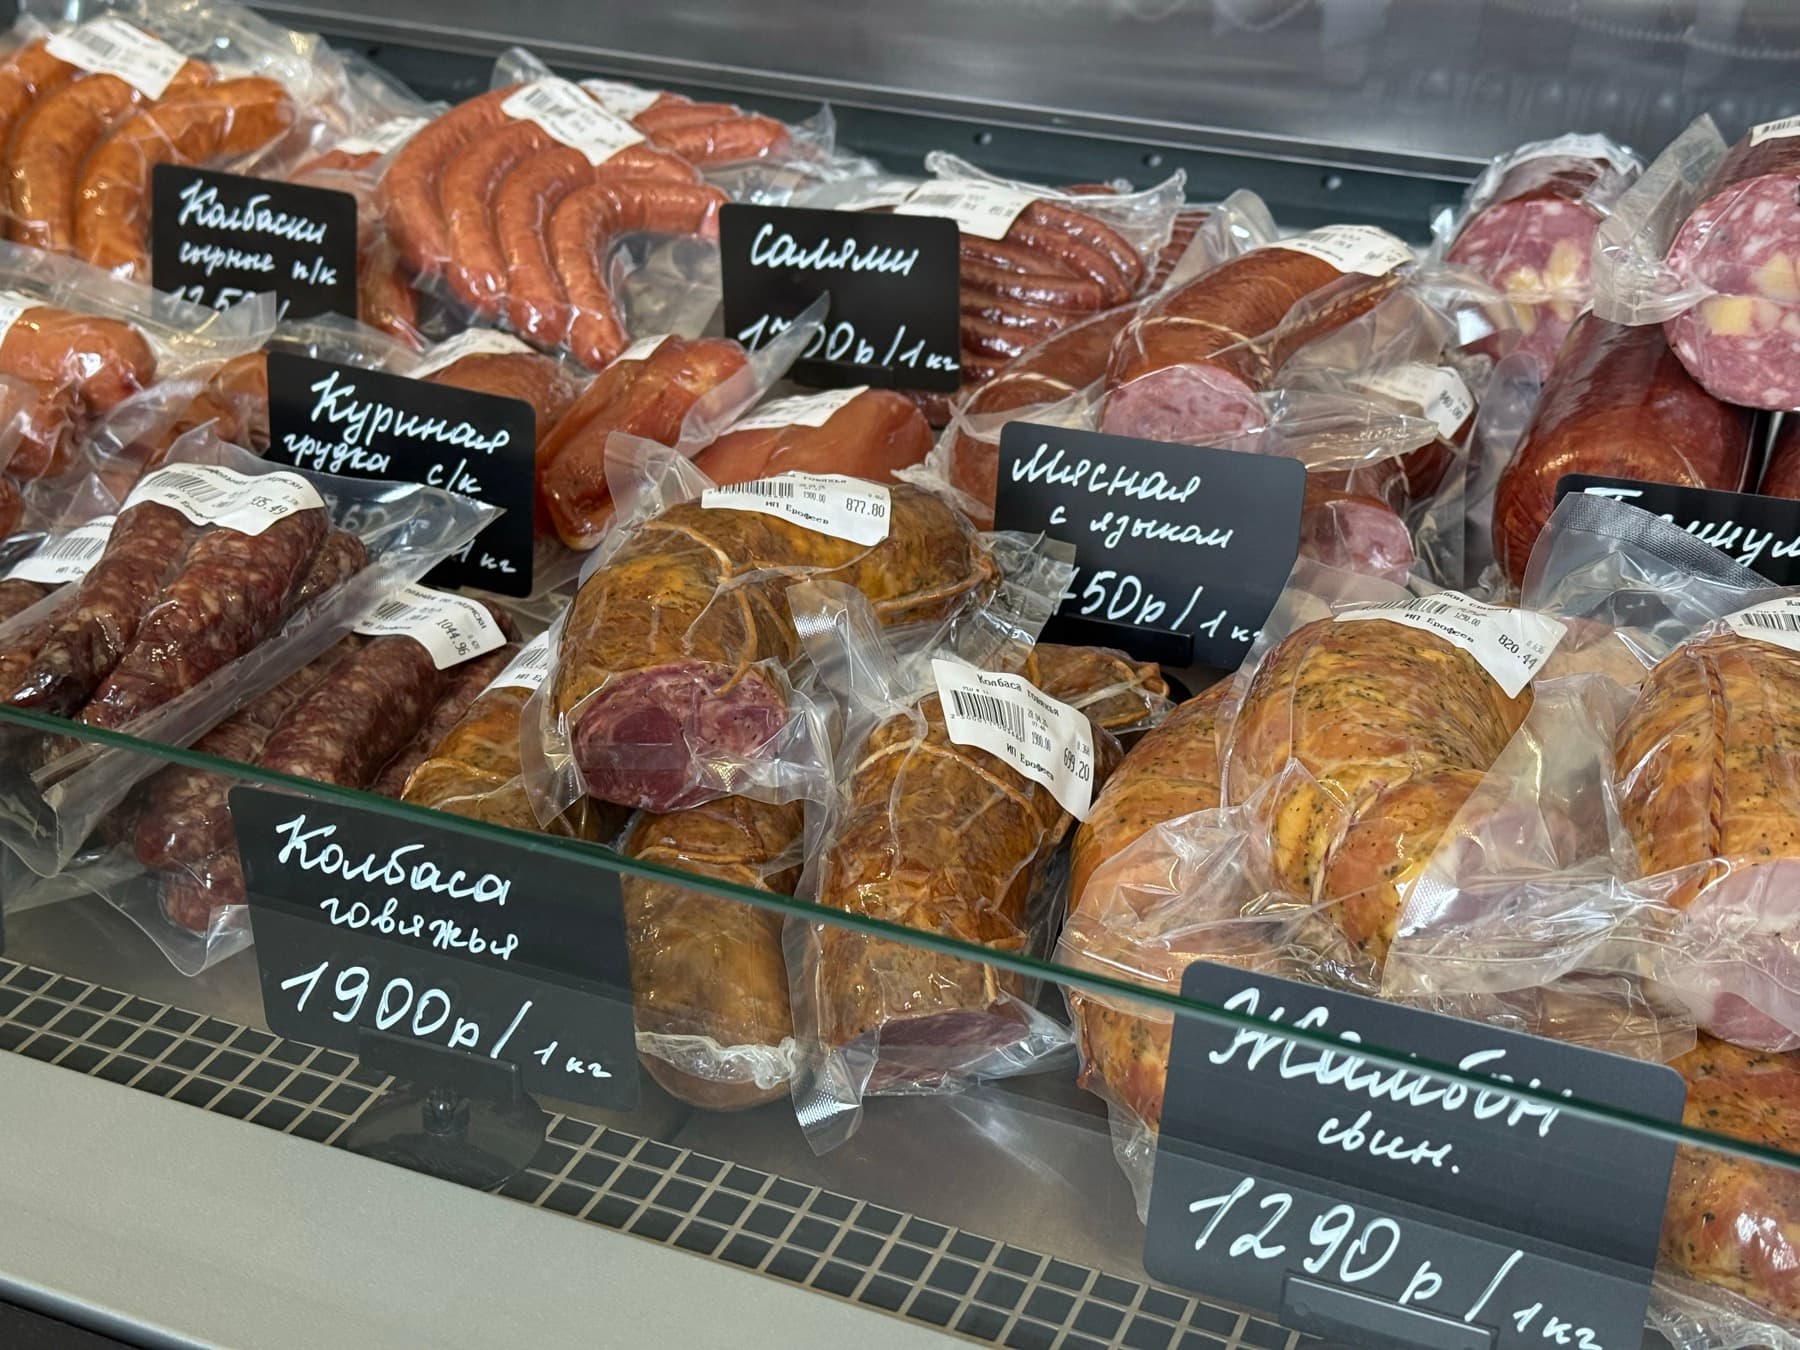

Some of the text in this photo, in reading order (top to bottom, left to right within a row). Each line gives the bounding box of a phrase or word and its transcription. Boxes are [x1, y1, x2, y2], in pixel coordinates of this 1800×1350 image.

[178, 178, 327, 244] Колбаски
[751, 223, 919, 276] Салями
[311, 371, 510, 454] Куриная
[283, 434, 390, 473] грудка
[1012, 443, 1201, 503] Мясная
[765, 500, 829, 525] ИП Ерофеев
[846, 497, 885, 518] 877.80
[1090, 512, 1234, 548] языком
[436, 618, 472, 656] 1044.96
[1426, 616, 1475, 643] Ерофеев
[1497, 633, 1539, 671] 820.44
[976, 673, 1023, 692] Колбаса
[1006, 742, 1054, 782] ИП Ерофеев
[1063, 747, 1090, 782] 699.20
[276, 815, 511, 906] Колбаса
[320, 898, 519, 961] говяжья
[1208, 987, 1573, 1137] Жамбон
[1317, 1111, 1460, 1174] свин.
